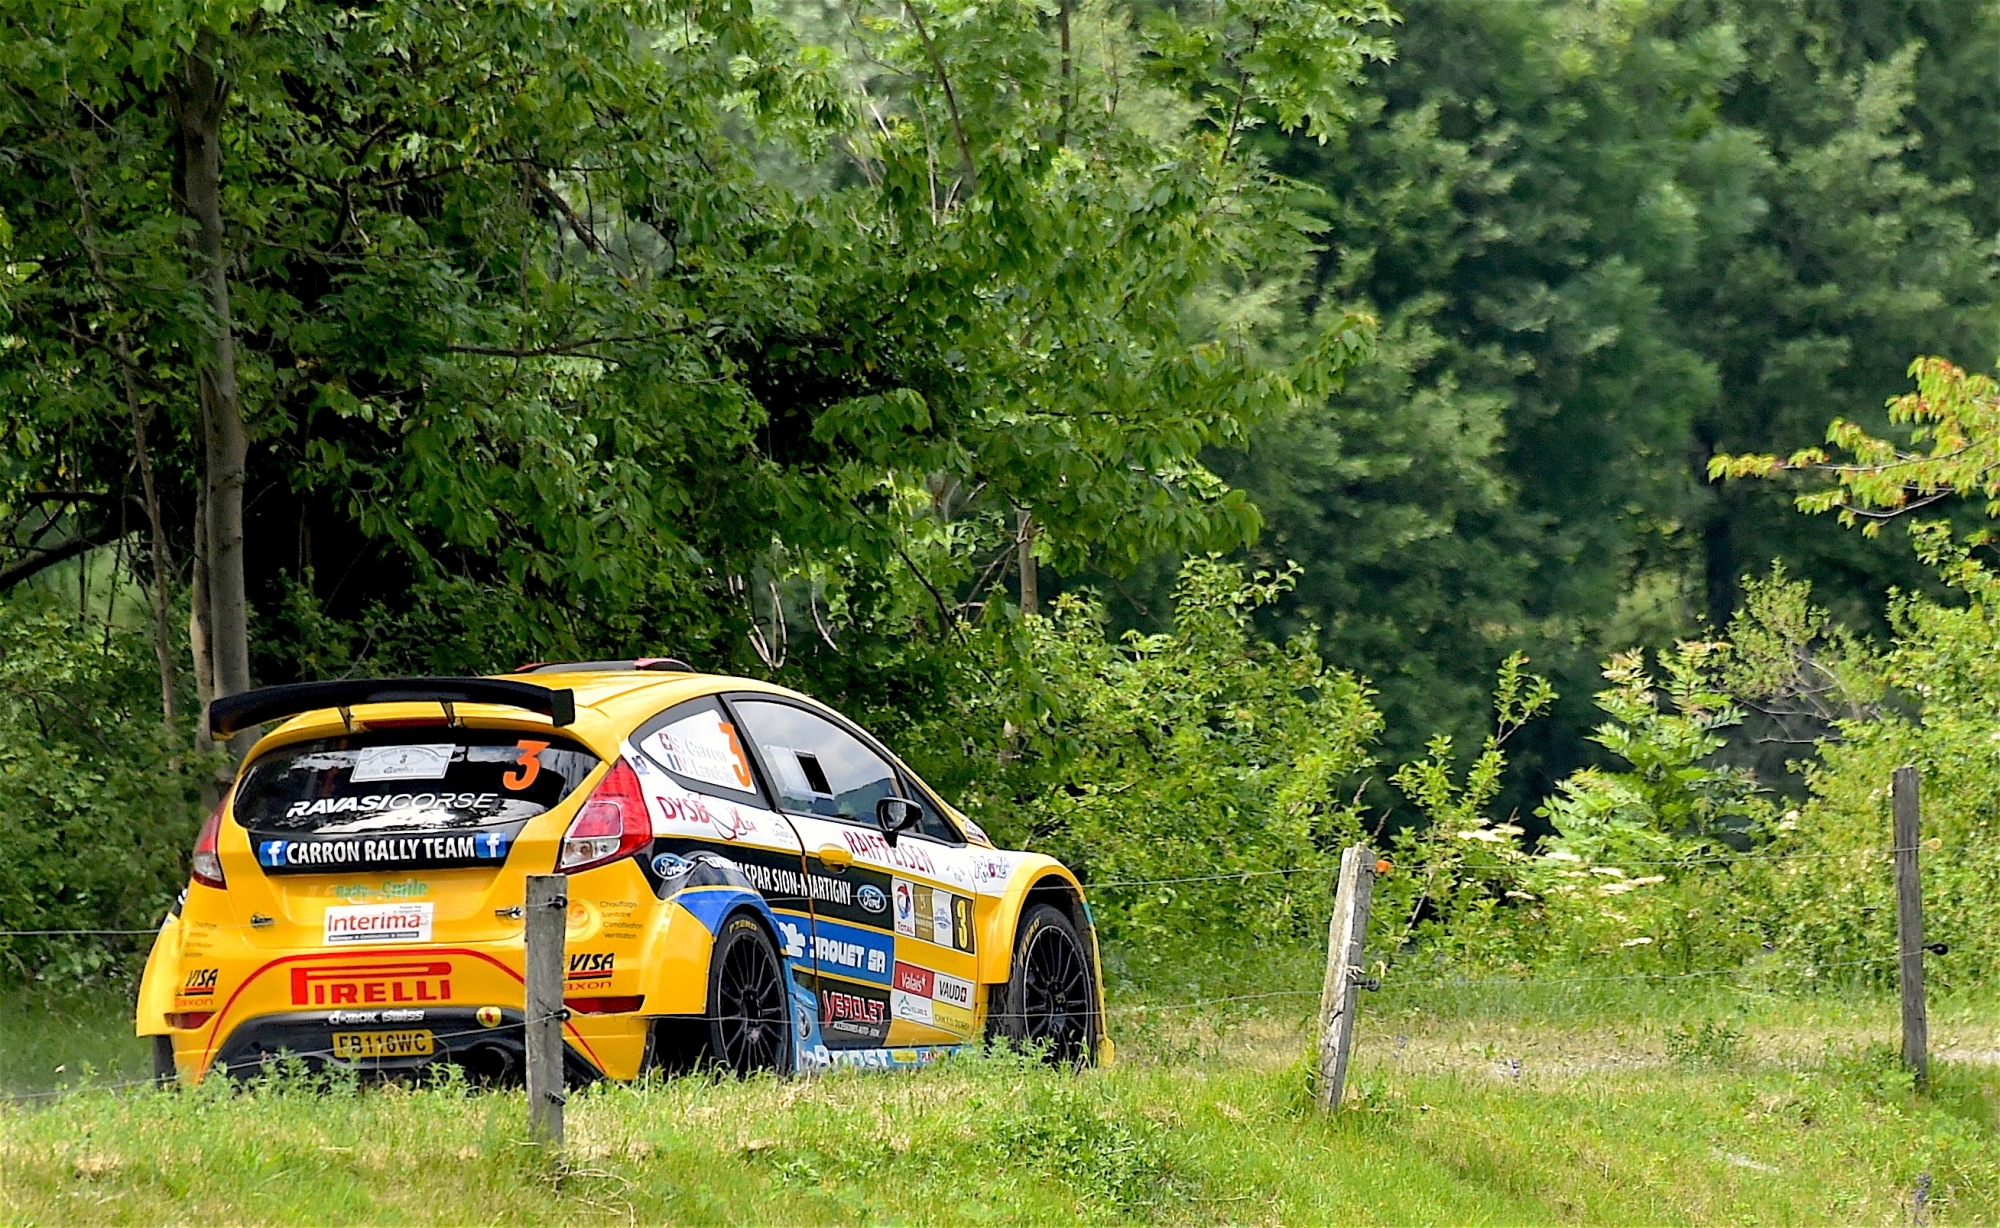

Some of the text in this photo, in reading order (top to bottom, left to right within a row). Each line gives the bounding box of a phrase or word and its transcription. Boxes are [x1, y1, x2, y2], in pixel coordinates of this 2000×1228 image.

[502, 739, 550, 790] 3
[718, 721, 751, 788] 3
[286, 792, 499, 818] RAVASICORSE
[286, 841, 360, 865] CARRON
[364, 838, 421, 862] RALLY
[422, 836, 475, 859] TEAM
[842, 829, 936, 875] RAIFFEISEN
[328, 911, 421, 932] Interima
[956, 900, 968, 949] 3
[569, 952, 615, 971] VISA
[867, 948, 886, 974] SA
[185, 968, 219, 987] VISA
[290, 961, 452, 1006] PIRELLI
[563, 980, 612, 991] axon
[939, 979, 960, 1001] VAUD
[174, 997, 213, 1008] Saxon
